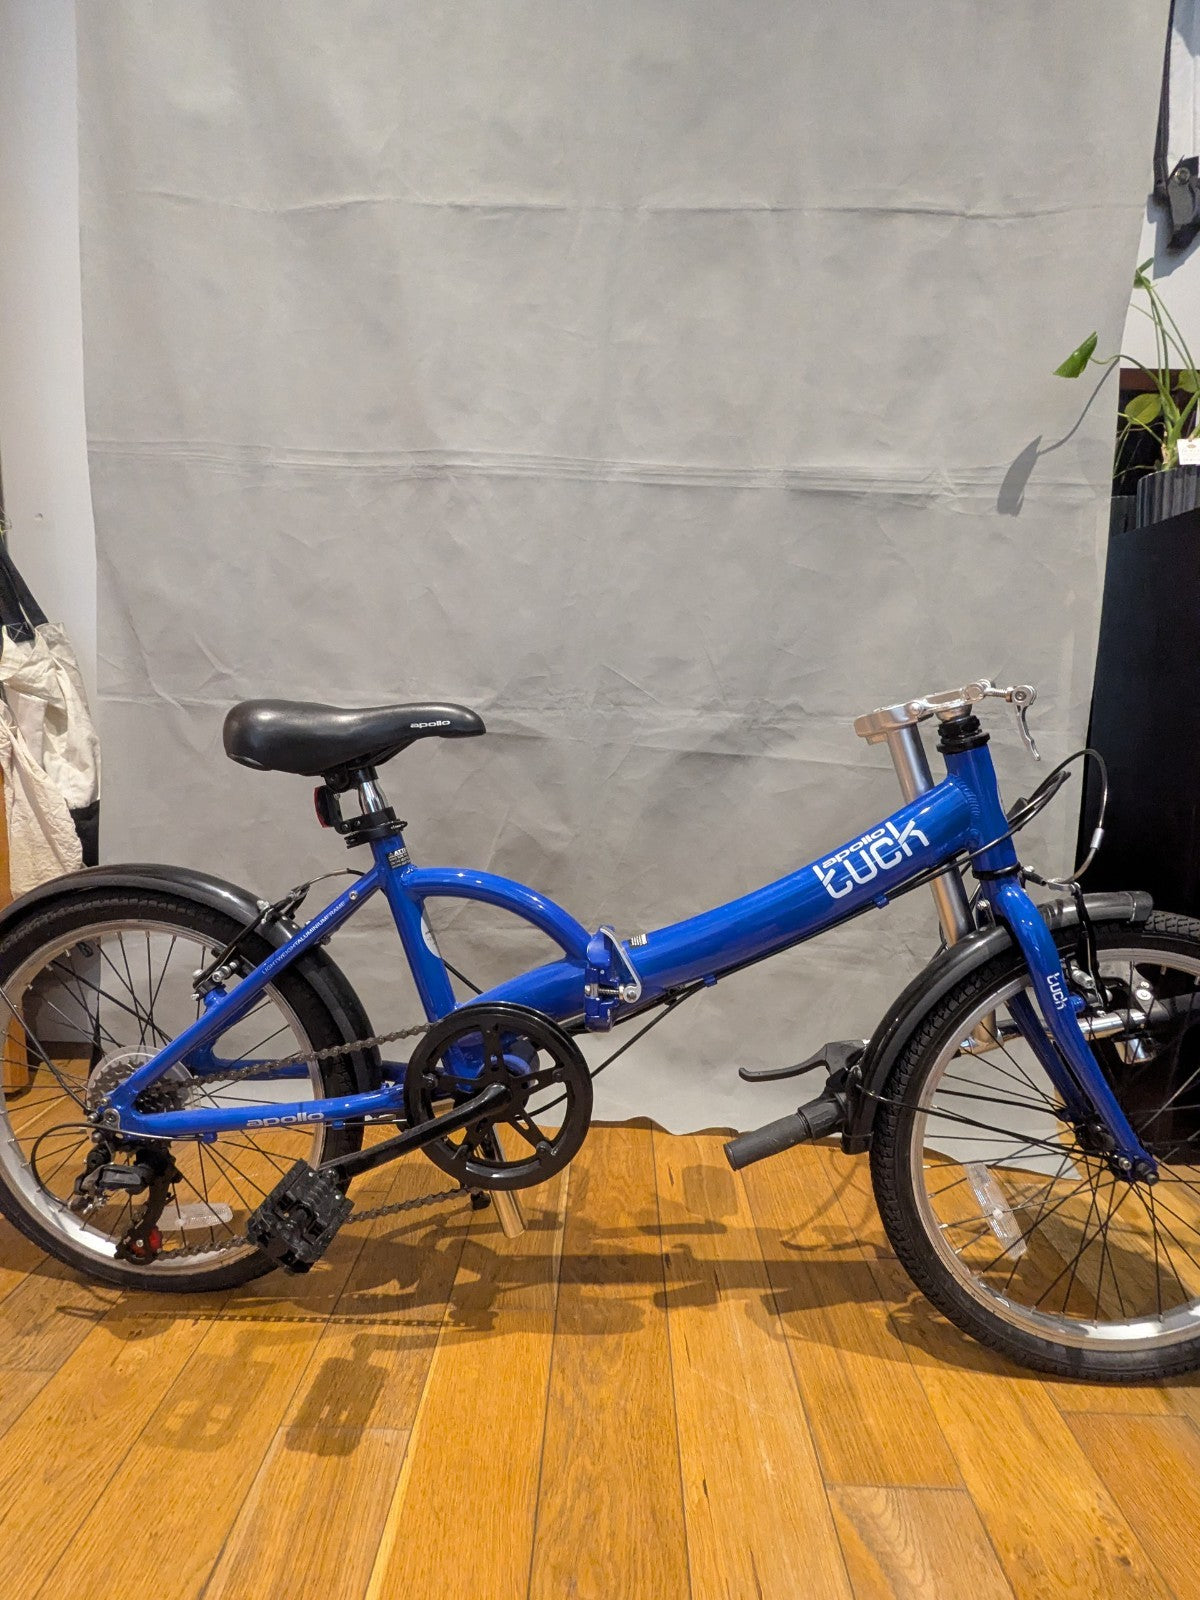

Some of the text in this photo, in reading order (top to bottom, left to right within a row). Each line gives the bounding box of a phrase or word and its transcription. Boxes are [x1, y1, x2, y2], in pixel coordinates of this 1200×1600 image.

[410, 719, 451, 729] apollo
[812, 820, 930, 899] tuck
[822, 828, 886, 868] apollo
[1046, 972, 1068, 1010] tuck
[246, 1111, 325, 1128] apollo
